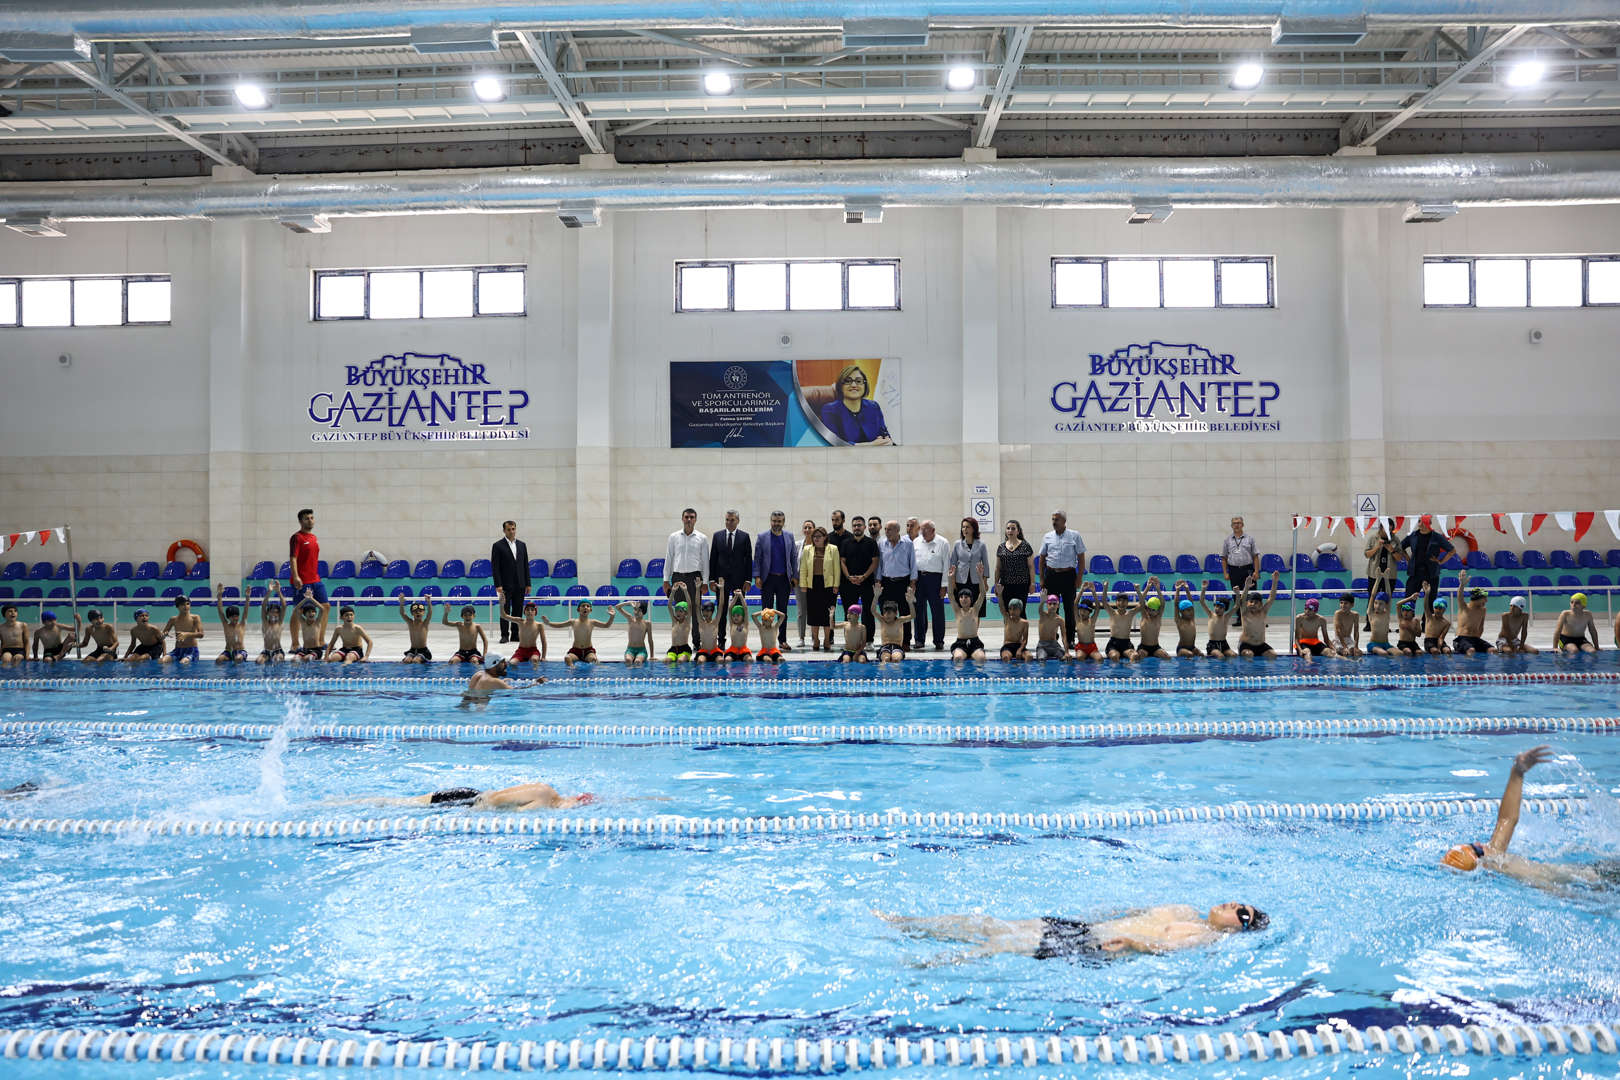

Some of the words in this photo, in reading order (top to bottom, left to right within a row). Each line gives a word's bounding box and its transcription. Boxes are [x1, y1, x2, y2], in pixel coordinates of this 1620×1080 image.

[309, 387, 529, 427] GAZİANTEP
[1051, 377, 1280, 417] GAZİANTEP
[311, 430, 378, 441] GAZİANTEP
[380, 429, 456, 441] BÜYÜKŞEHİR
[458, 429, 529, 440] BELEDİYESİ
[1055, 421, 1125, 432] GAZİANTEP
[1128, 421, 1207, 433] BÜYÜKŞEHİR
[1209, 420, 1281, 432] BELEDİYESİ
